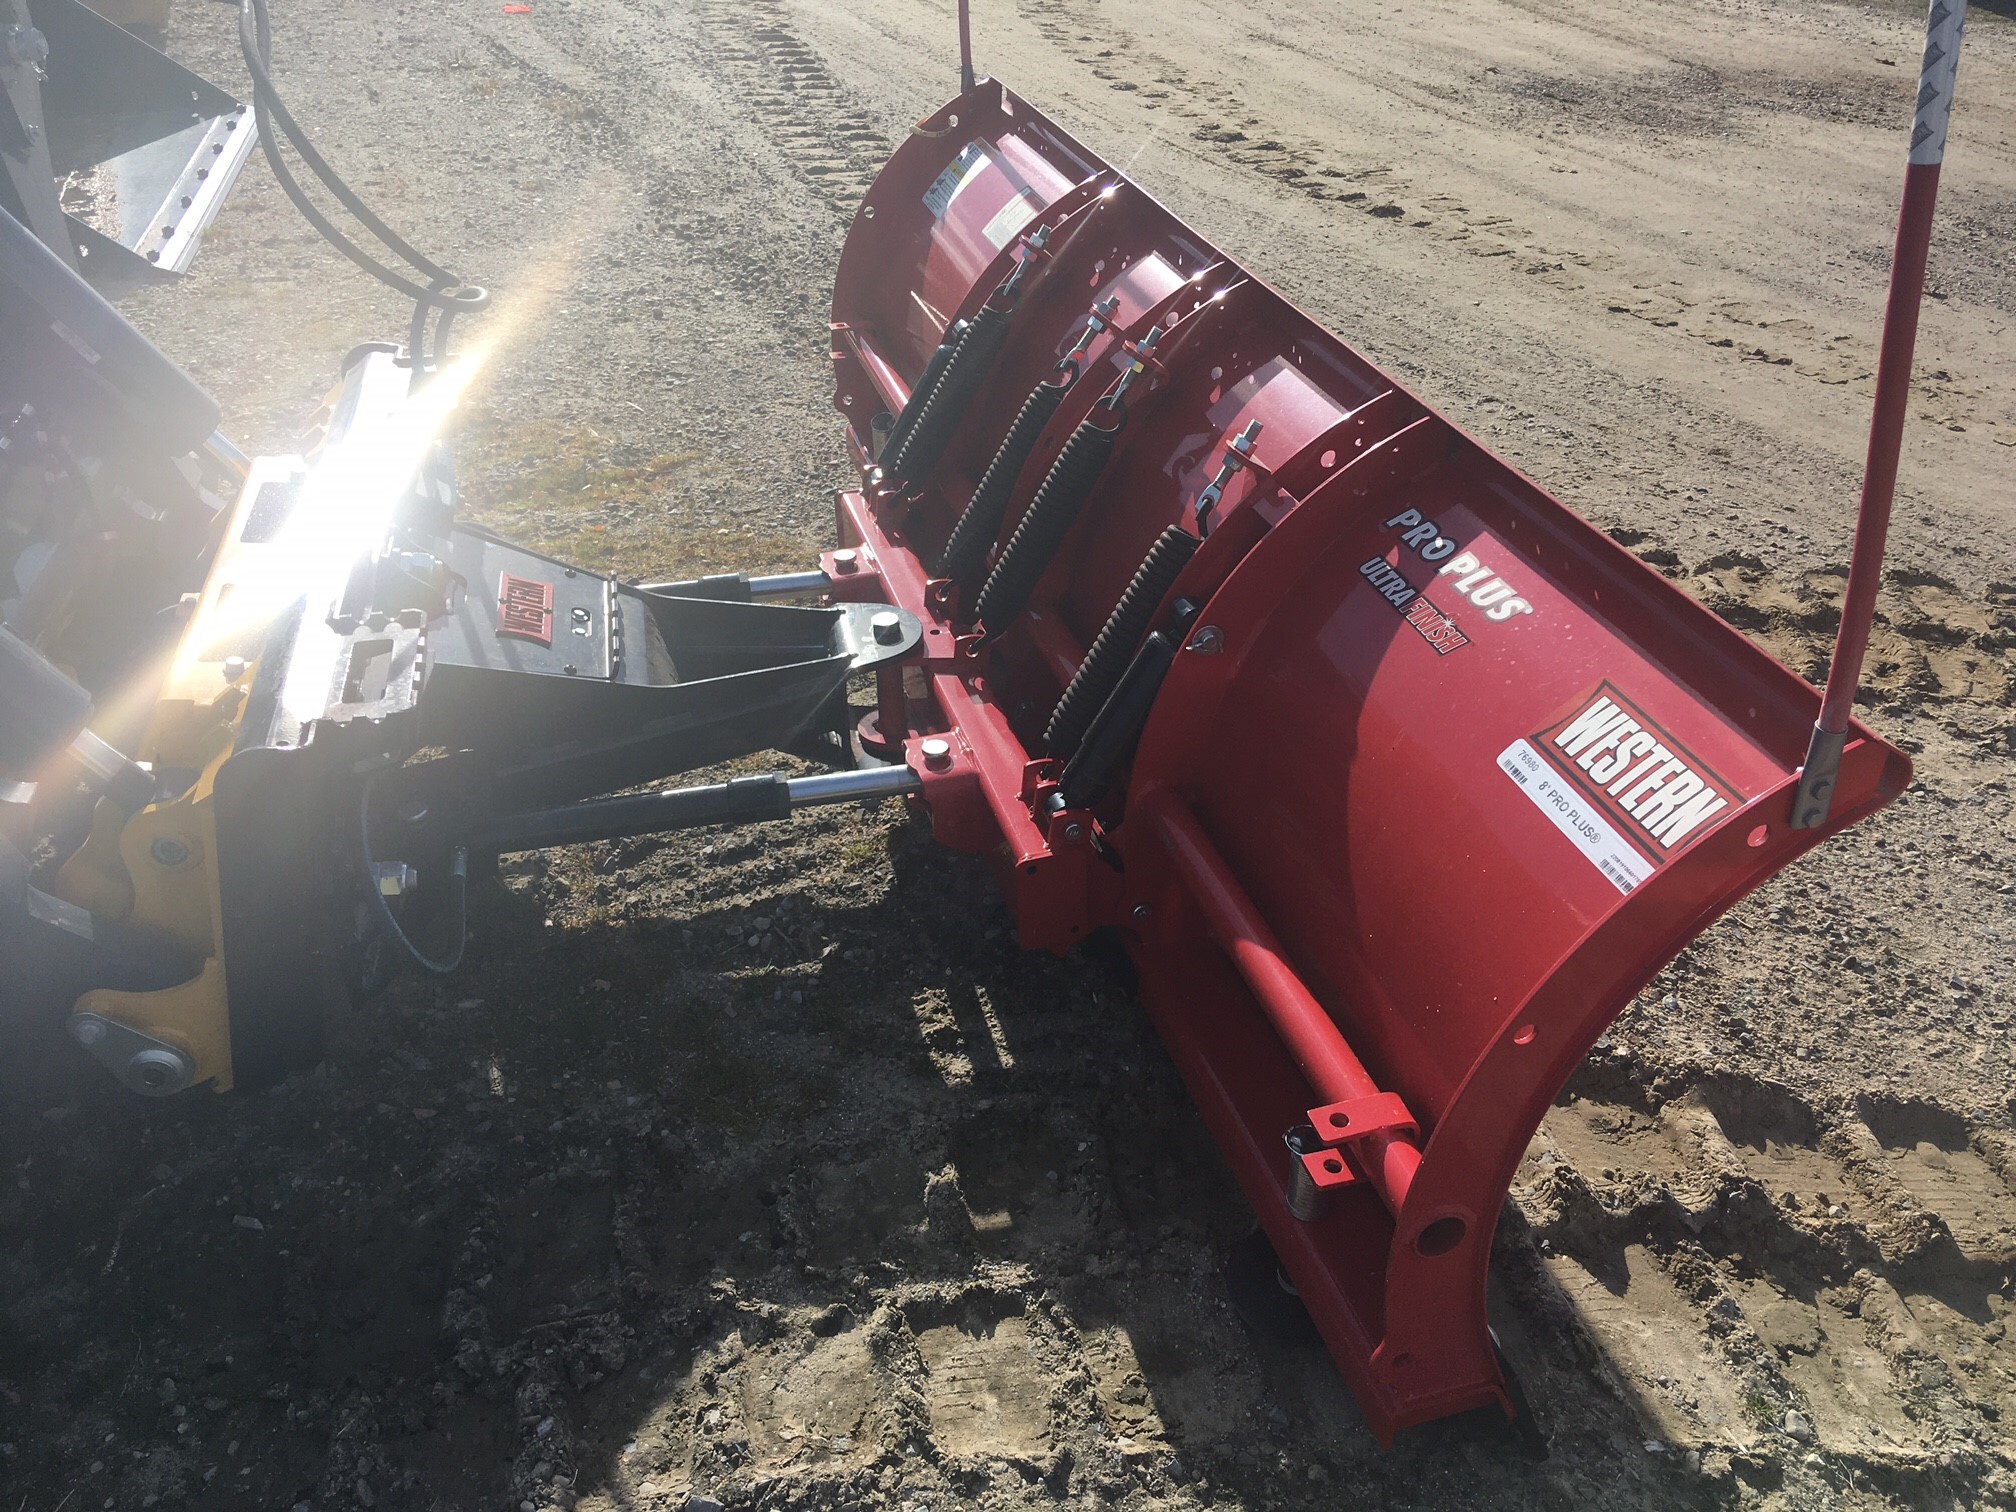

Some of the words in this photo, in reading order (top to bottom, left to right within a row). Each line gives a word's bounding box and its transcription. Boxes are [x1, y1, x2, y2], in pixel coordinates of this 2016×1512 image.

[1386, 508, 1457, 561] PRO
[505, 578, 547, 634] WESTERN
[1359, 556, 1416, 608] ULTRA
[1401, 597, 1468, 655] FINISH
[1516, 749, 1540, 773] 76980
[1553, 695, 1728, 849] WESTERN
[1546, 788, 1570, 813] PRO
